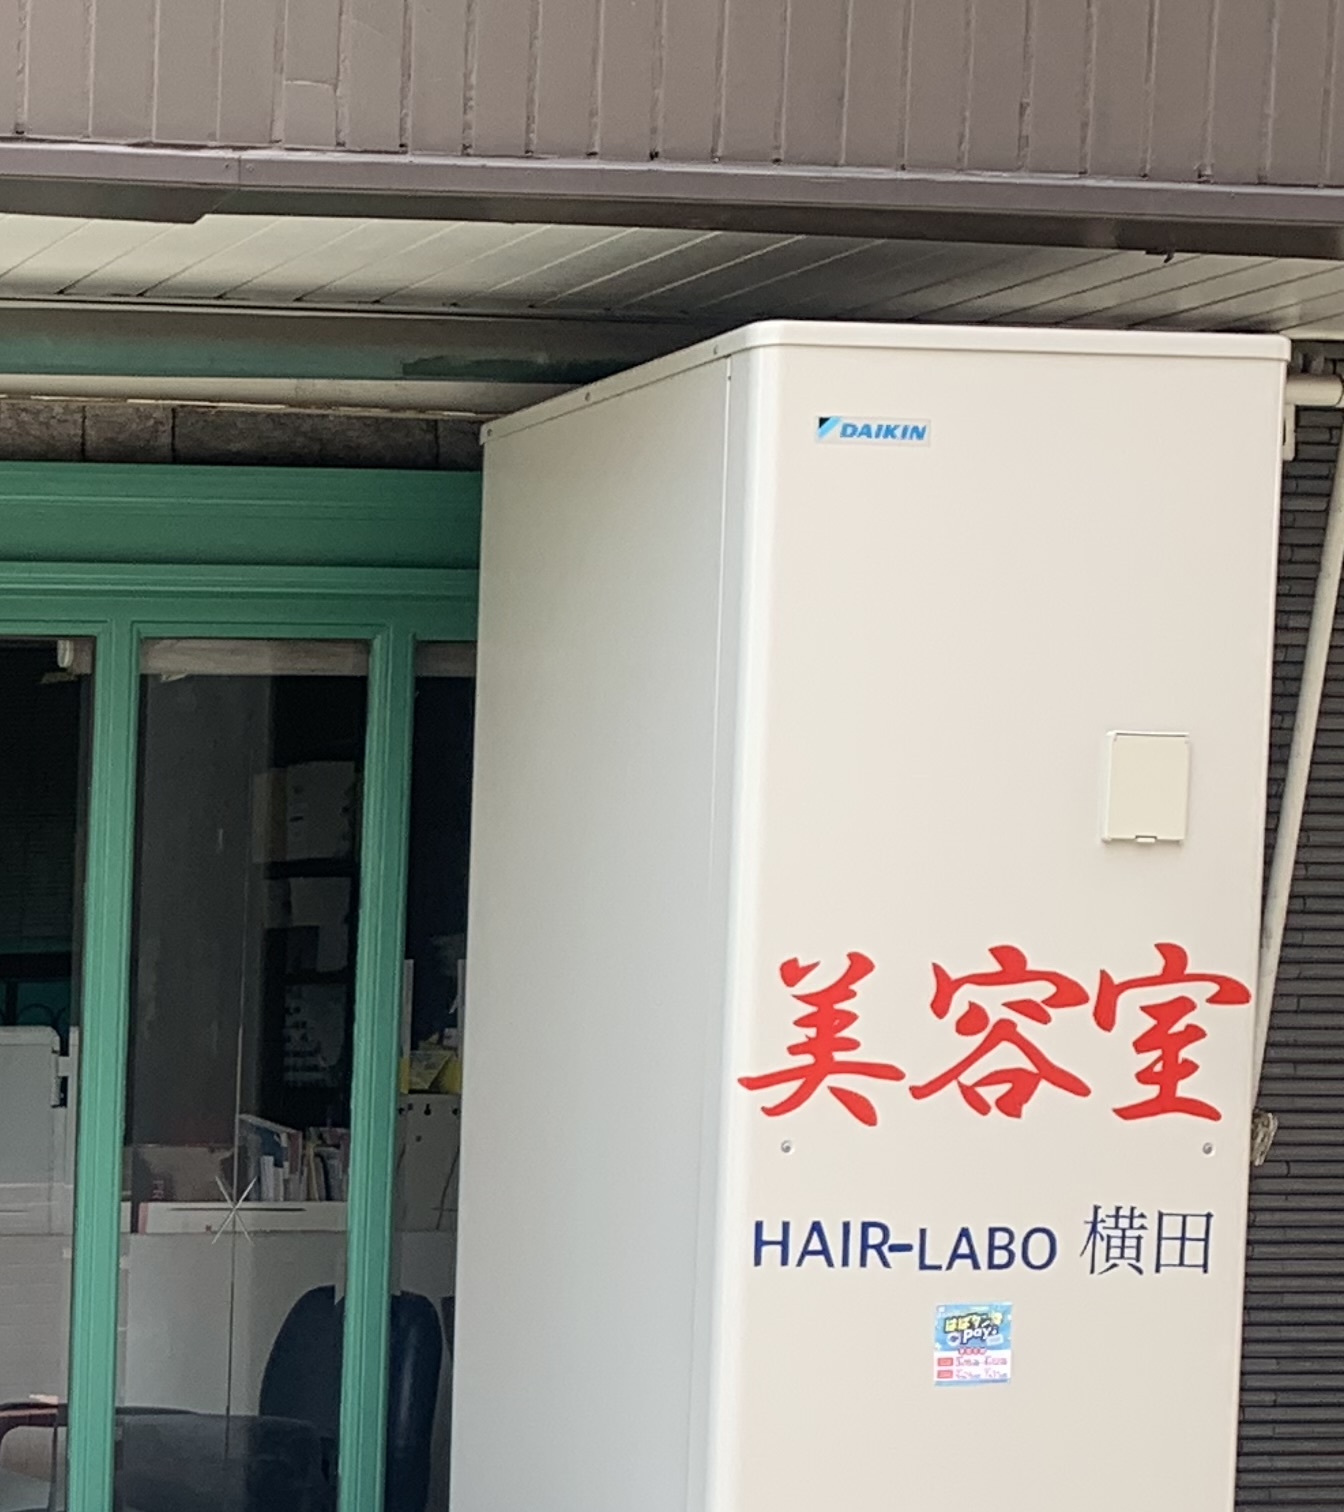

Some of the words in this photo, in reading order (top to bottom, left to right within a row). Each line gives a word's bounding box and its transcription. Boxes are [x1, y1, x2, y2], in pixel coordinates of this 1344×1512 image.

[840, 422, 927, 440] DAIKIN
[737, 943, 1252, 1127] 美容室
[753, 1220, 1058, 1272] HAIR-LABO
[1079, 1204, 1214, 1276] 横田
